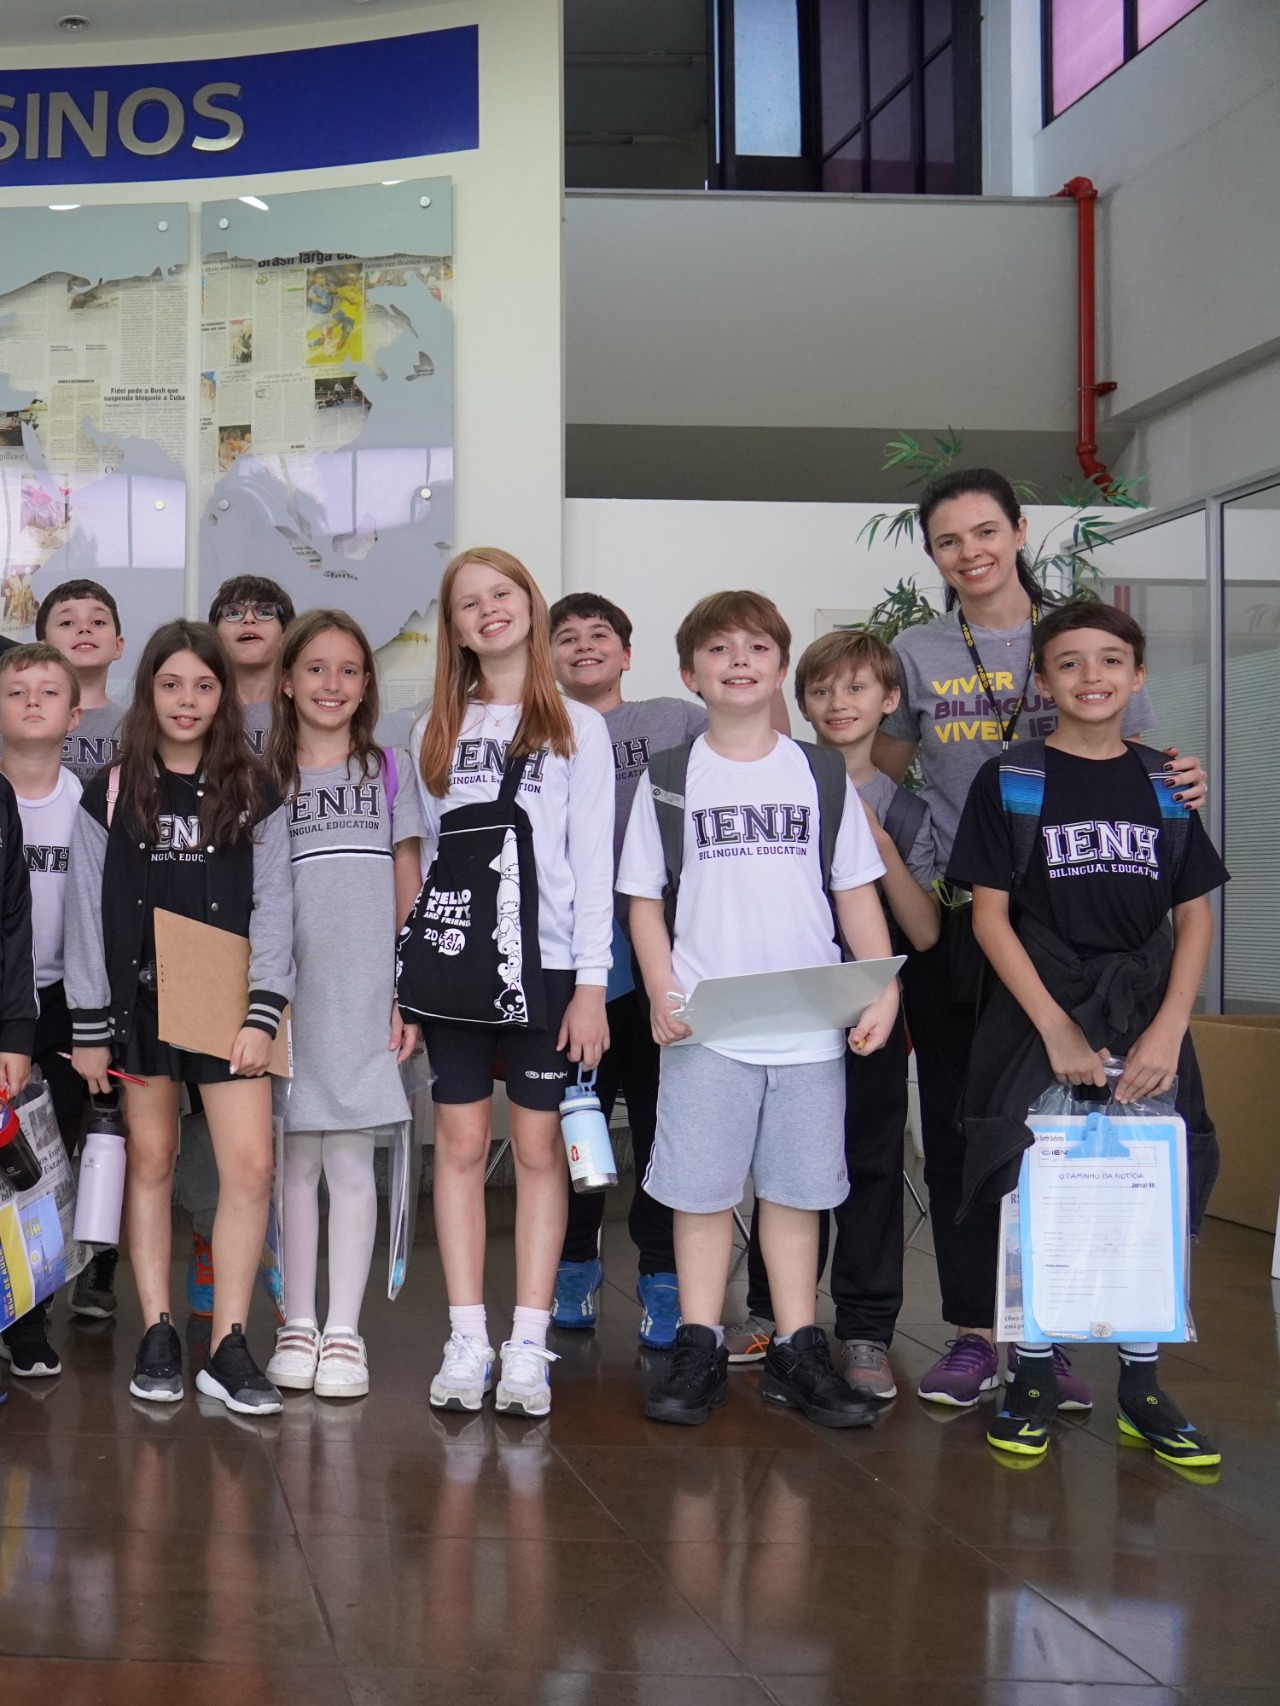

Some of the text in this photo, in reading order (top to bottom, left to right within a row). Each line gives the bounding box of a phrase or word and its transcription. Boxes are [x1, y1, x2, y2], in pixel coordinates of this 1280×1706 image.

[931, 671, 1015, 696] VIVER
[61, 736, 120, 765] EN
[449, 737, 550, 782] ENH
[286, 783, 380, 826] ENH
[155, 813, 201, 851] EN
[289, 821, 380, 838] INGUAL EDUCATION
[692, 803, 811, 848] IENH
[699, 847, 754, 861] BILINGUAL
[1042, 820, 1159, 868] IENH
[23, 844, 70, 873] NH
[179, 853, 205, 863] EDUC
[1049, 863, 1109, 879] BILINGUAL
[423, 911, 440, 920] AND
[423, 927, 438, 941] 2D
[540, 1071, 568, 1080] IENH
[1115, 1171, 1144, 1180] NOTÍCIA
